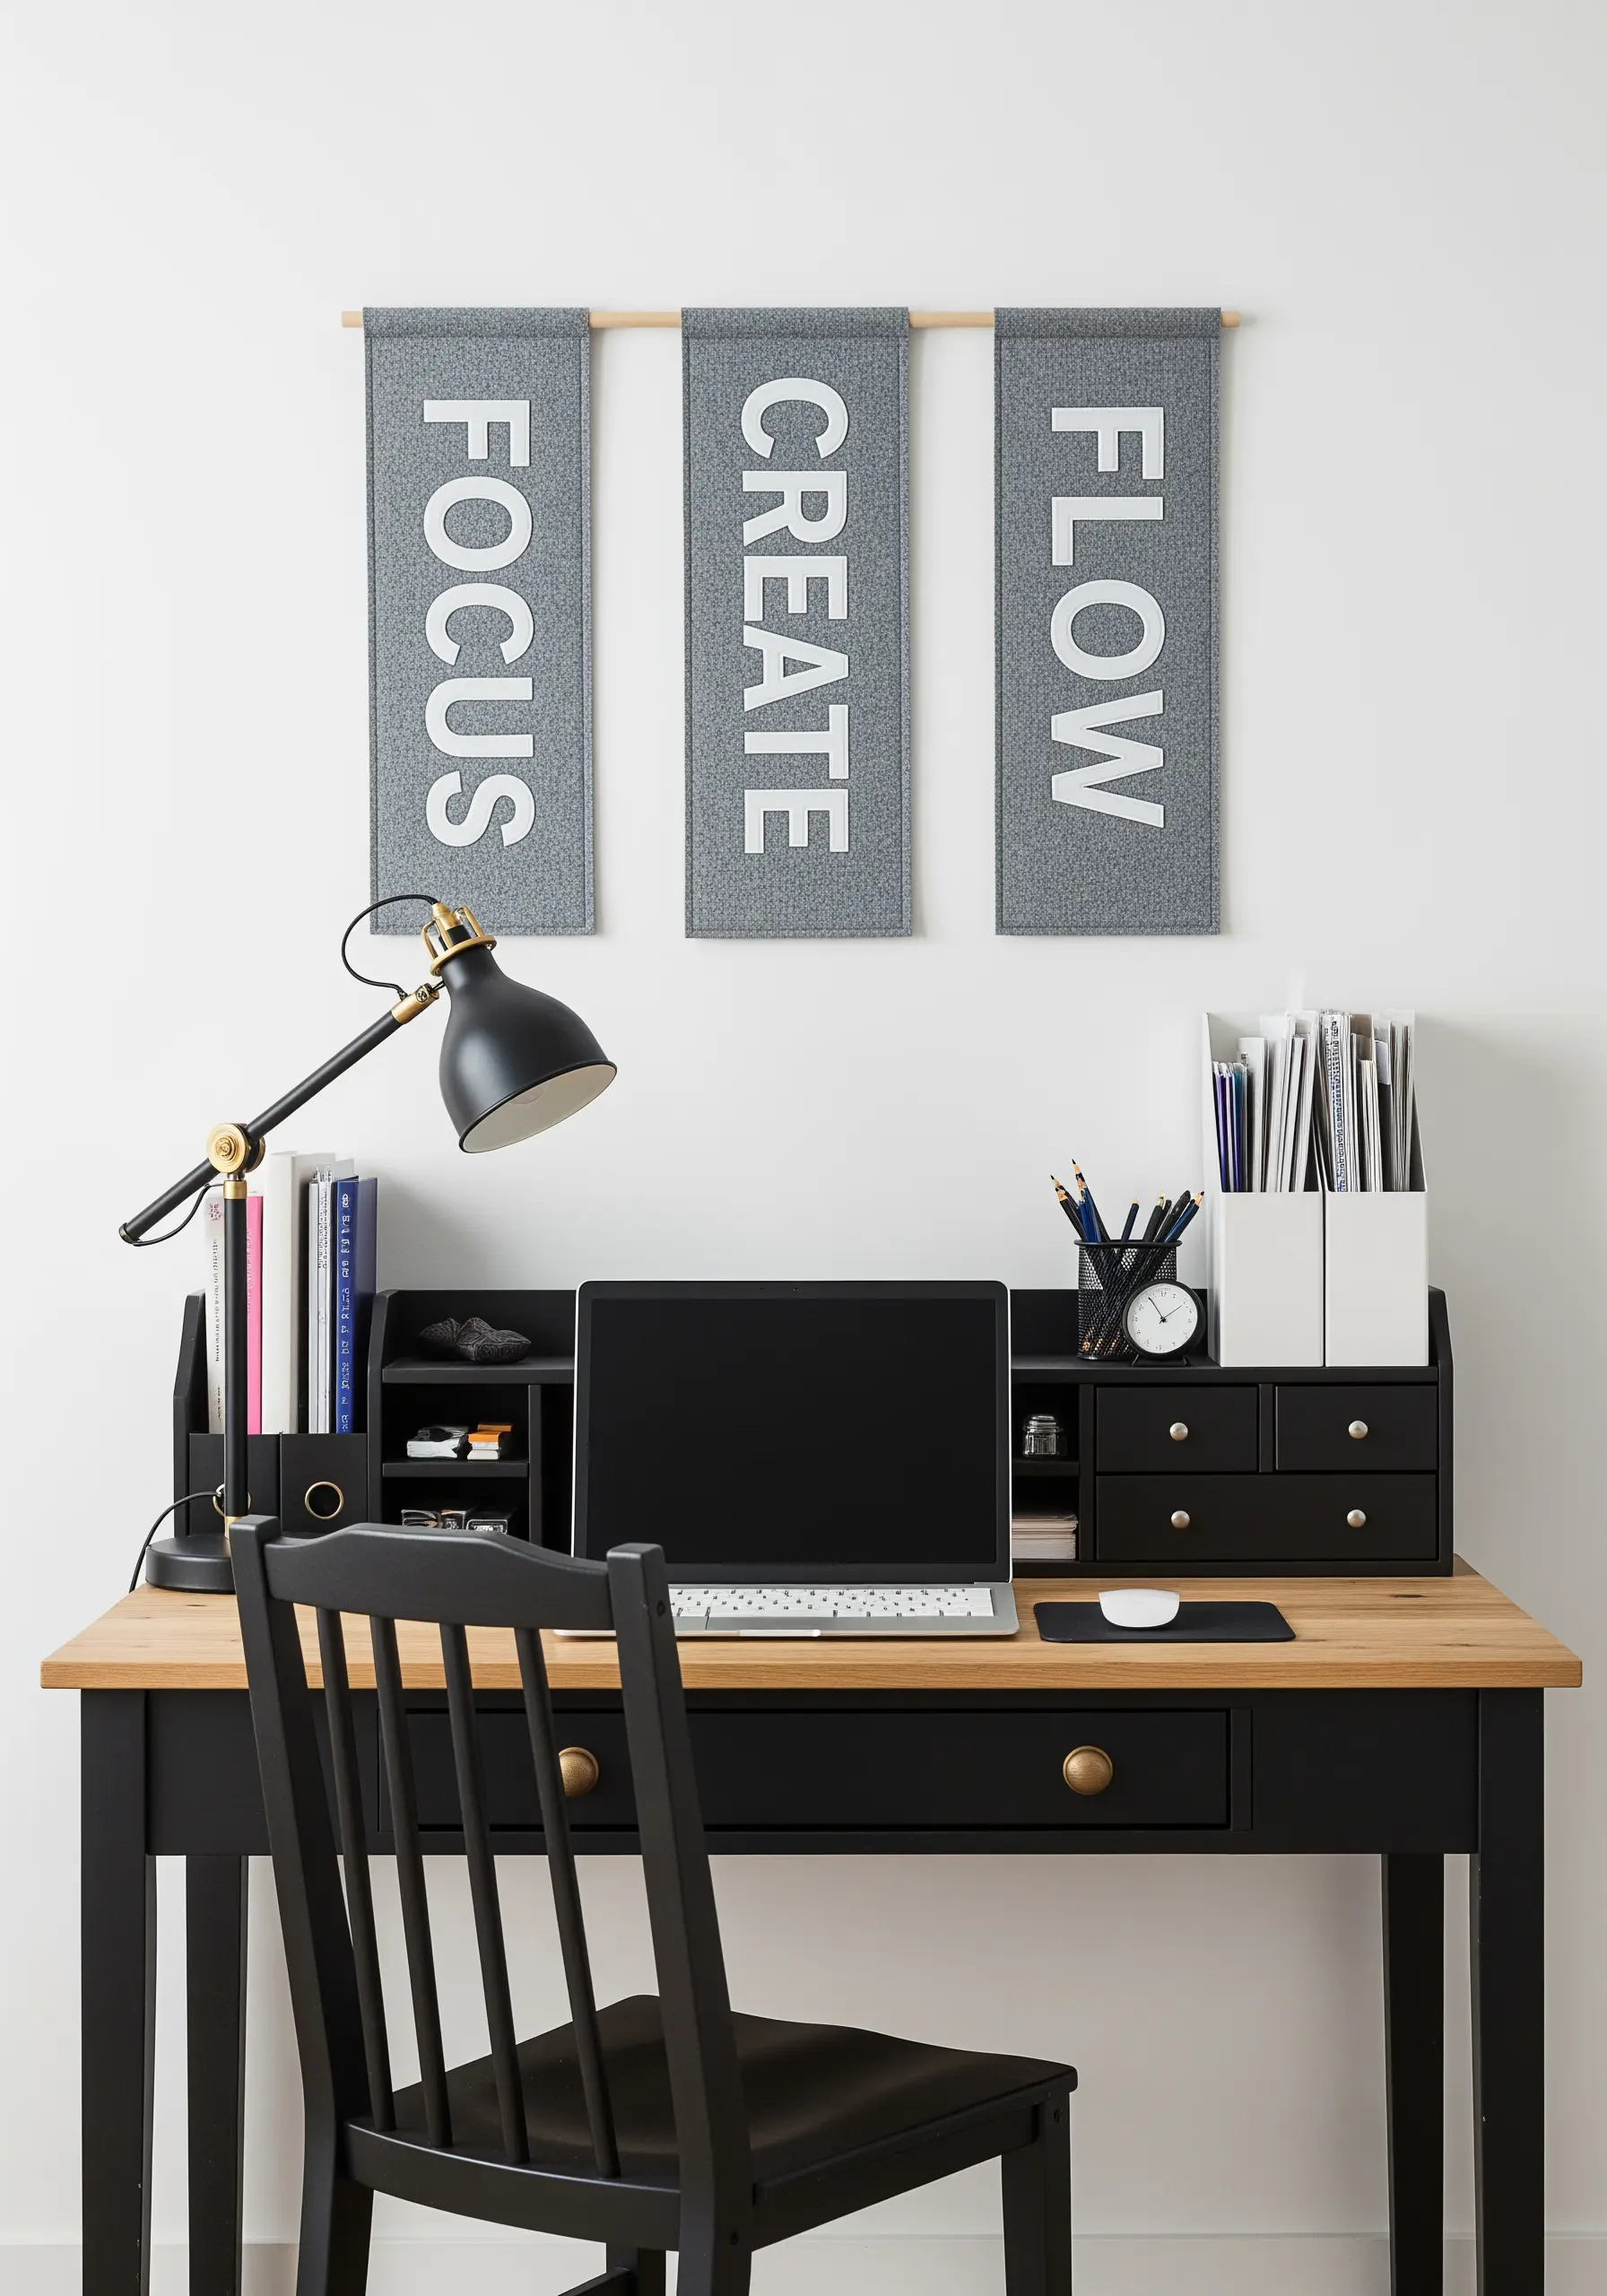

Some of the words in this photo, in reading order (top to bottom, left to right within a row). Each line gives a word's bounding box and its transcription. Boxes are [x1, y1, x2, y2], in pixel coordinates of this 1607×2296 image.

[422, 399, 535, 849] FOCUS
[741, 377, 849, 854] CREATE
[1050, 406, 1165, 829] FLOW
